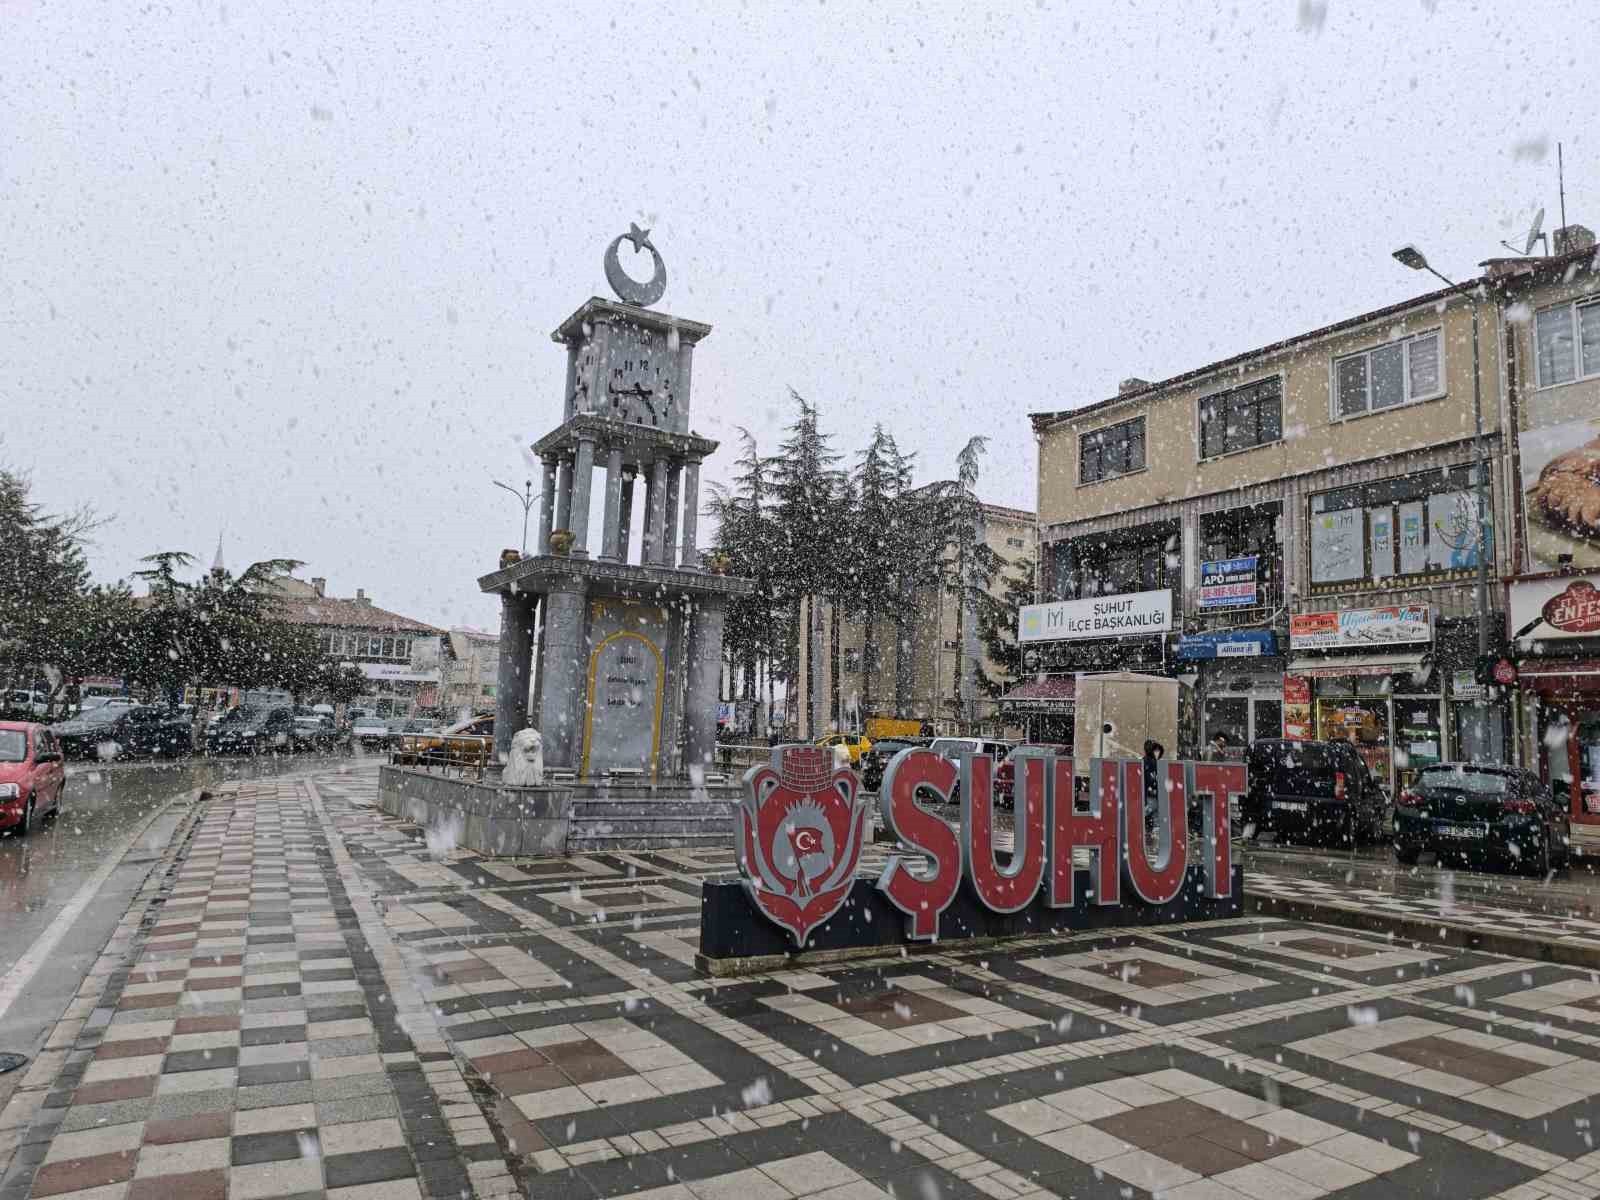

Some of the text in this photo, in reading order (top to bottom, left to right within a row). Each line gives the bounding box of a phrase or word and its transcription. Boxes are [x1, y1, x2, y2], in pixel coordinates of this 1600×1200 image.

[624, 360, 633, 371] 11
[639, 359, 649, 371] 12
[1093, 600, 1134, 615] ŞUHUT
[1047, 607, 1064, 627] İYİ
[1068, 610, 1165, 633] İLÇE BAŞKANLIĞI
[875, 747, 1248, 941] ŞUHUT
